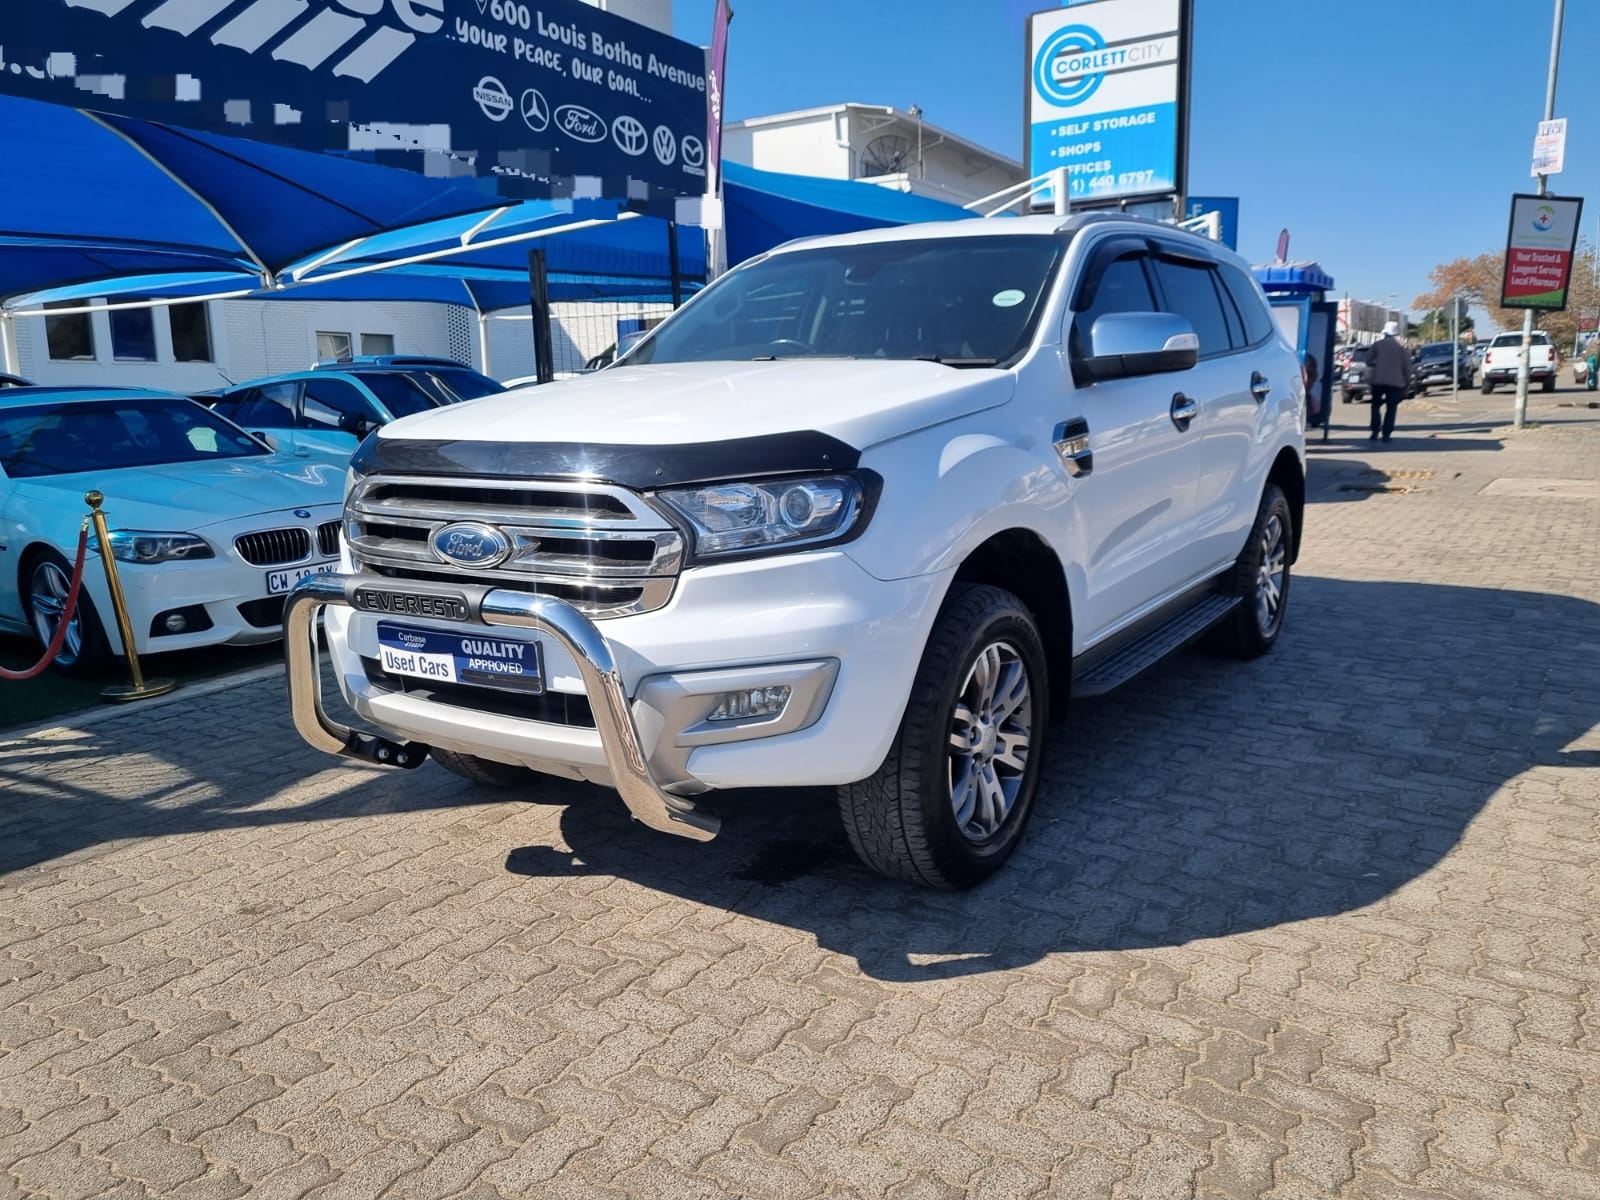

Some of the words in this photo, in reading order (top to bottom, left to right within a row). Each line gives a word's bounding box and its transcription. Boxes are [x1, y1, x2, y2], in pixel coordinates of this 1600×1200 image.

[490, 0, 531, 31] 600
[537, 10, 586, 51] Louis
[591, 31, 643, 71] Botha
[646, 53, 706, 92] Avenue
[513, 37, 567, 77] PEACE,
[571, 57, 603, 86] OUR
[476, 90, 511, 107] NISSAN
[564, 109, 598, 136] Ford
[1058, 121, 1090, 137] SELF
[1093, 111, 1156, 132] STORAGE
[1058, 141, 1102, 158] SHOPS
[1057, 160, 1112, 177] FFICES
[1088, 173, 1114, 188] 440
[1118, 169, 1154, 185] 6797
[1532, 253, 1555, 263] Trusted
[1511, 276, 1529, 286] Local
[1529, 277, 1560, 290] Pharmacy
[447, 532, 484, 558] Ford
[270, 573, 289, 591] CW
[365, 591, 459, 617] EVEREST
[398, 632, 427, 644] Carbase
[461, 639, 525, 660] QUALITY
[385, 652, 416, 673] Used
[419, 656, 449, 678] Cars
[468, 658, 523, 674] APPROVED
